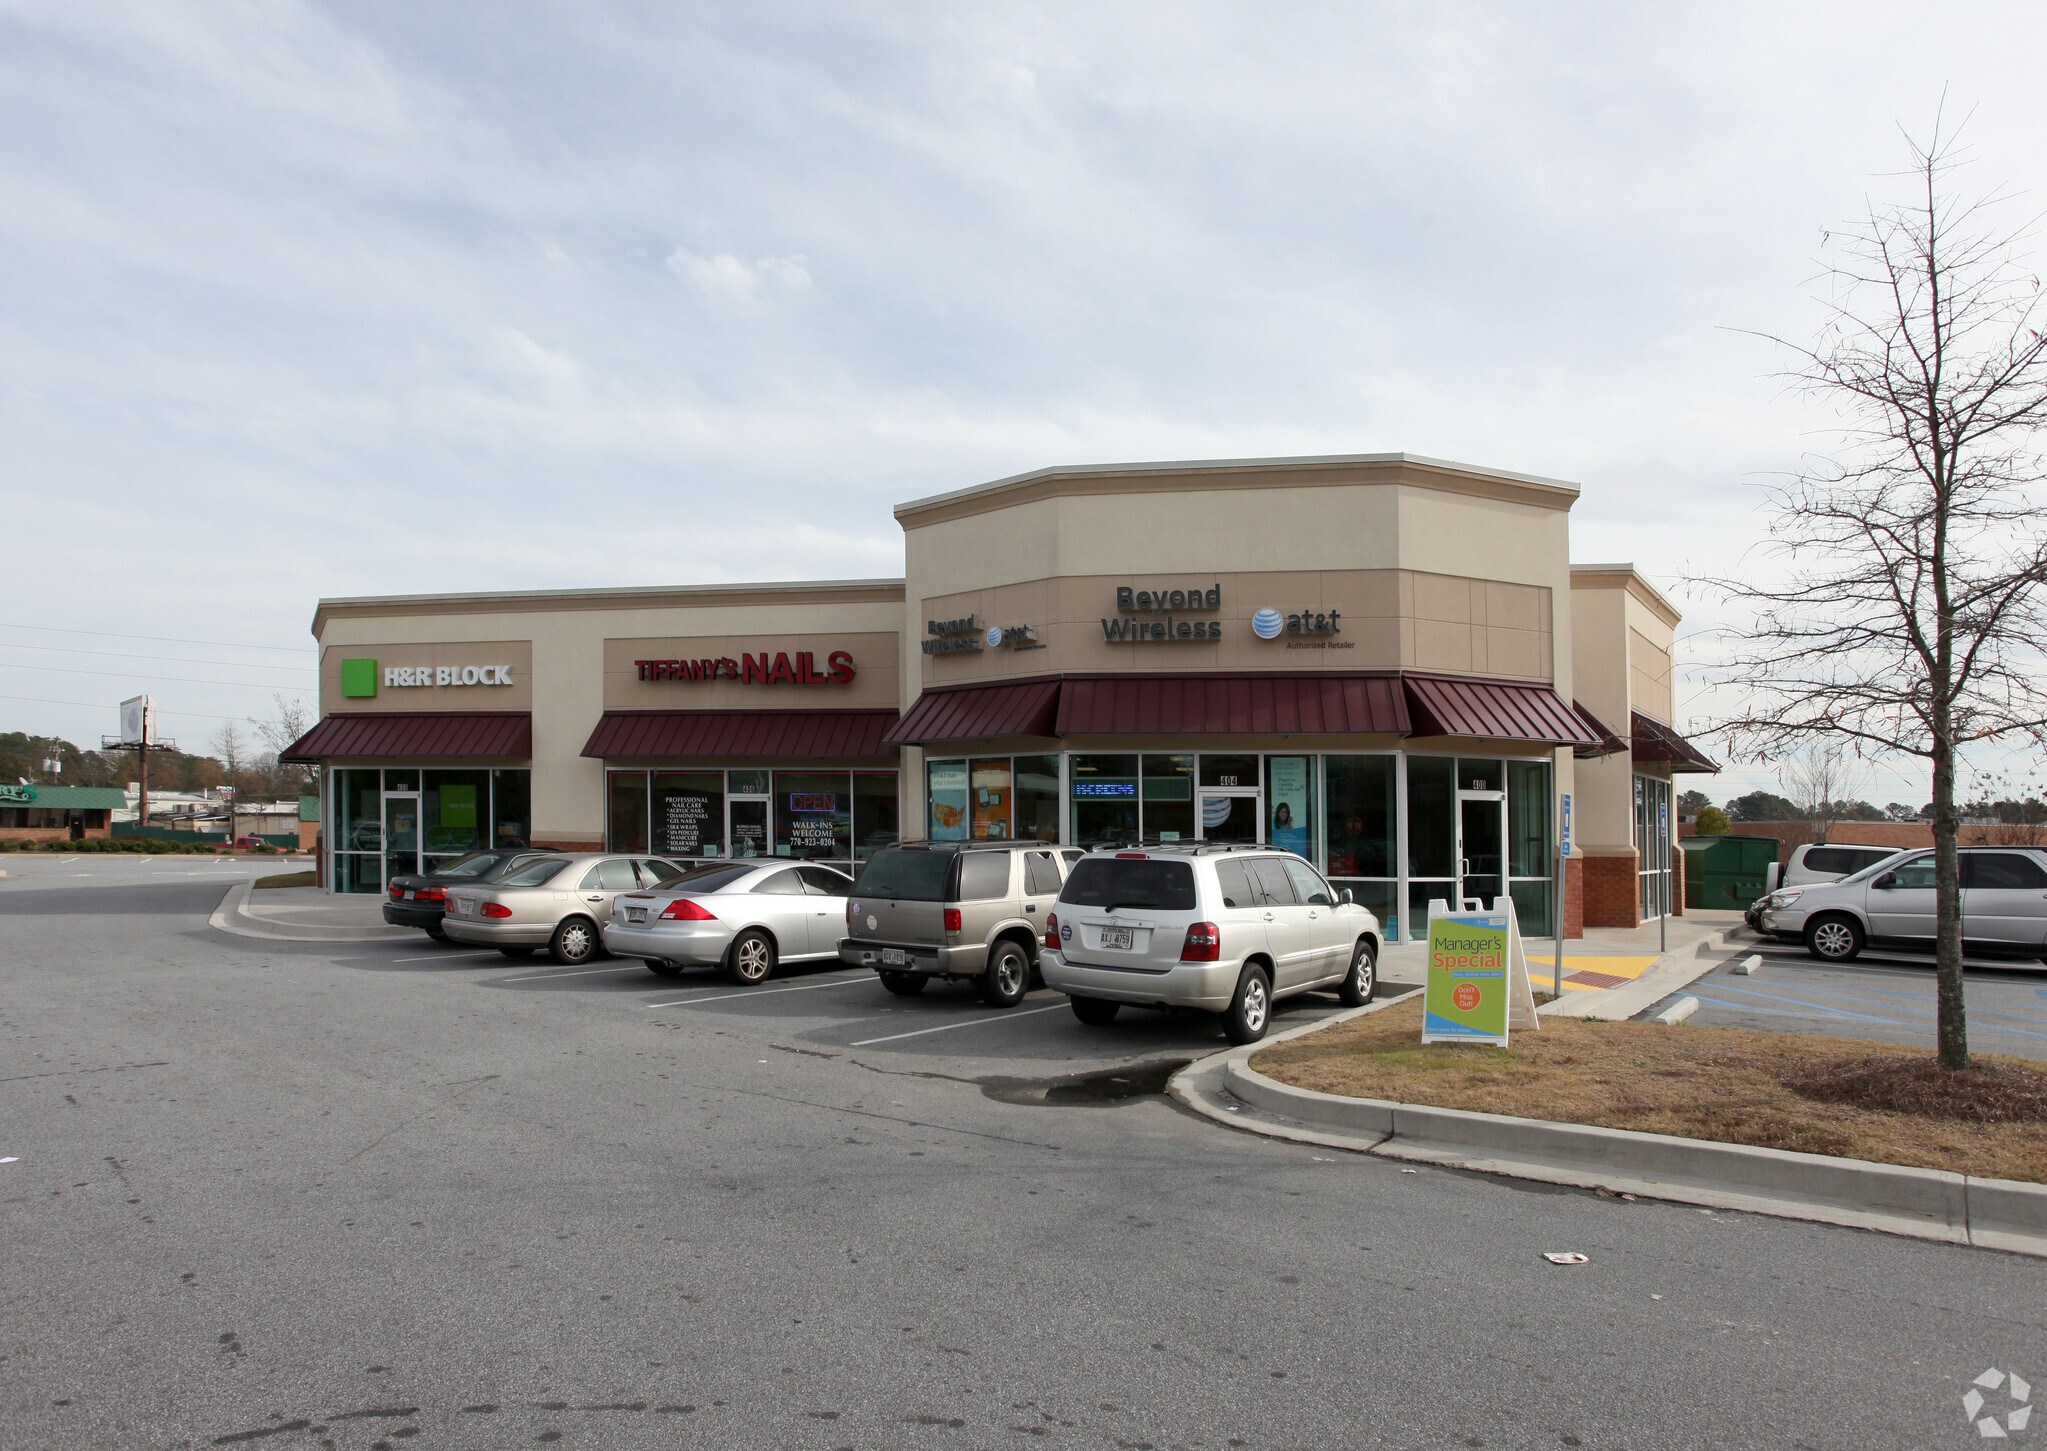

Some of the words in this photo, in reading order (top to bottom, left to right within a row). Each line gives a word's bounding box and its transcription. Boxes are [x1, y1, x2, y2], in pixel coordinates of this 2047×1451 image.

[1116, 583, 1221, 615] Beyond
[927, 613, 977, 637] Beyond
[1101, 617, 1222, 641] Wireless
[1286, 609, 1341, 634] at&t
[1286, 642, 1326, 650] Authorized
[1327, 641, 1356, 649] Retailer
[384, 666, 433, 687] H&R
[436, 665, 514, 686] BLOCK
[634, 656, 738, 682] TIFFANY'S
[741, 650, 856, 686] NAILS
[1220, 775, 1238, 786] 404
[1473, 779, 1487, 790] 400
[792, 795, 834, 810] OPEN
[792, 821, 834, 829] WALK-INS
[792, 829, 834, 838] WELCOME
[790, 837, 836, 847] 770-923-0204
[1434, 936, 1502, 955] Manager's
[1432, 951, 1503, 972] Special
